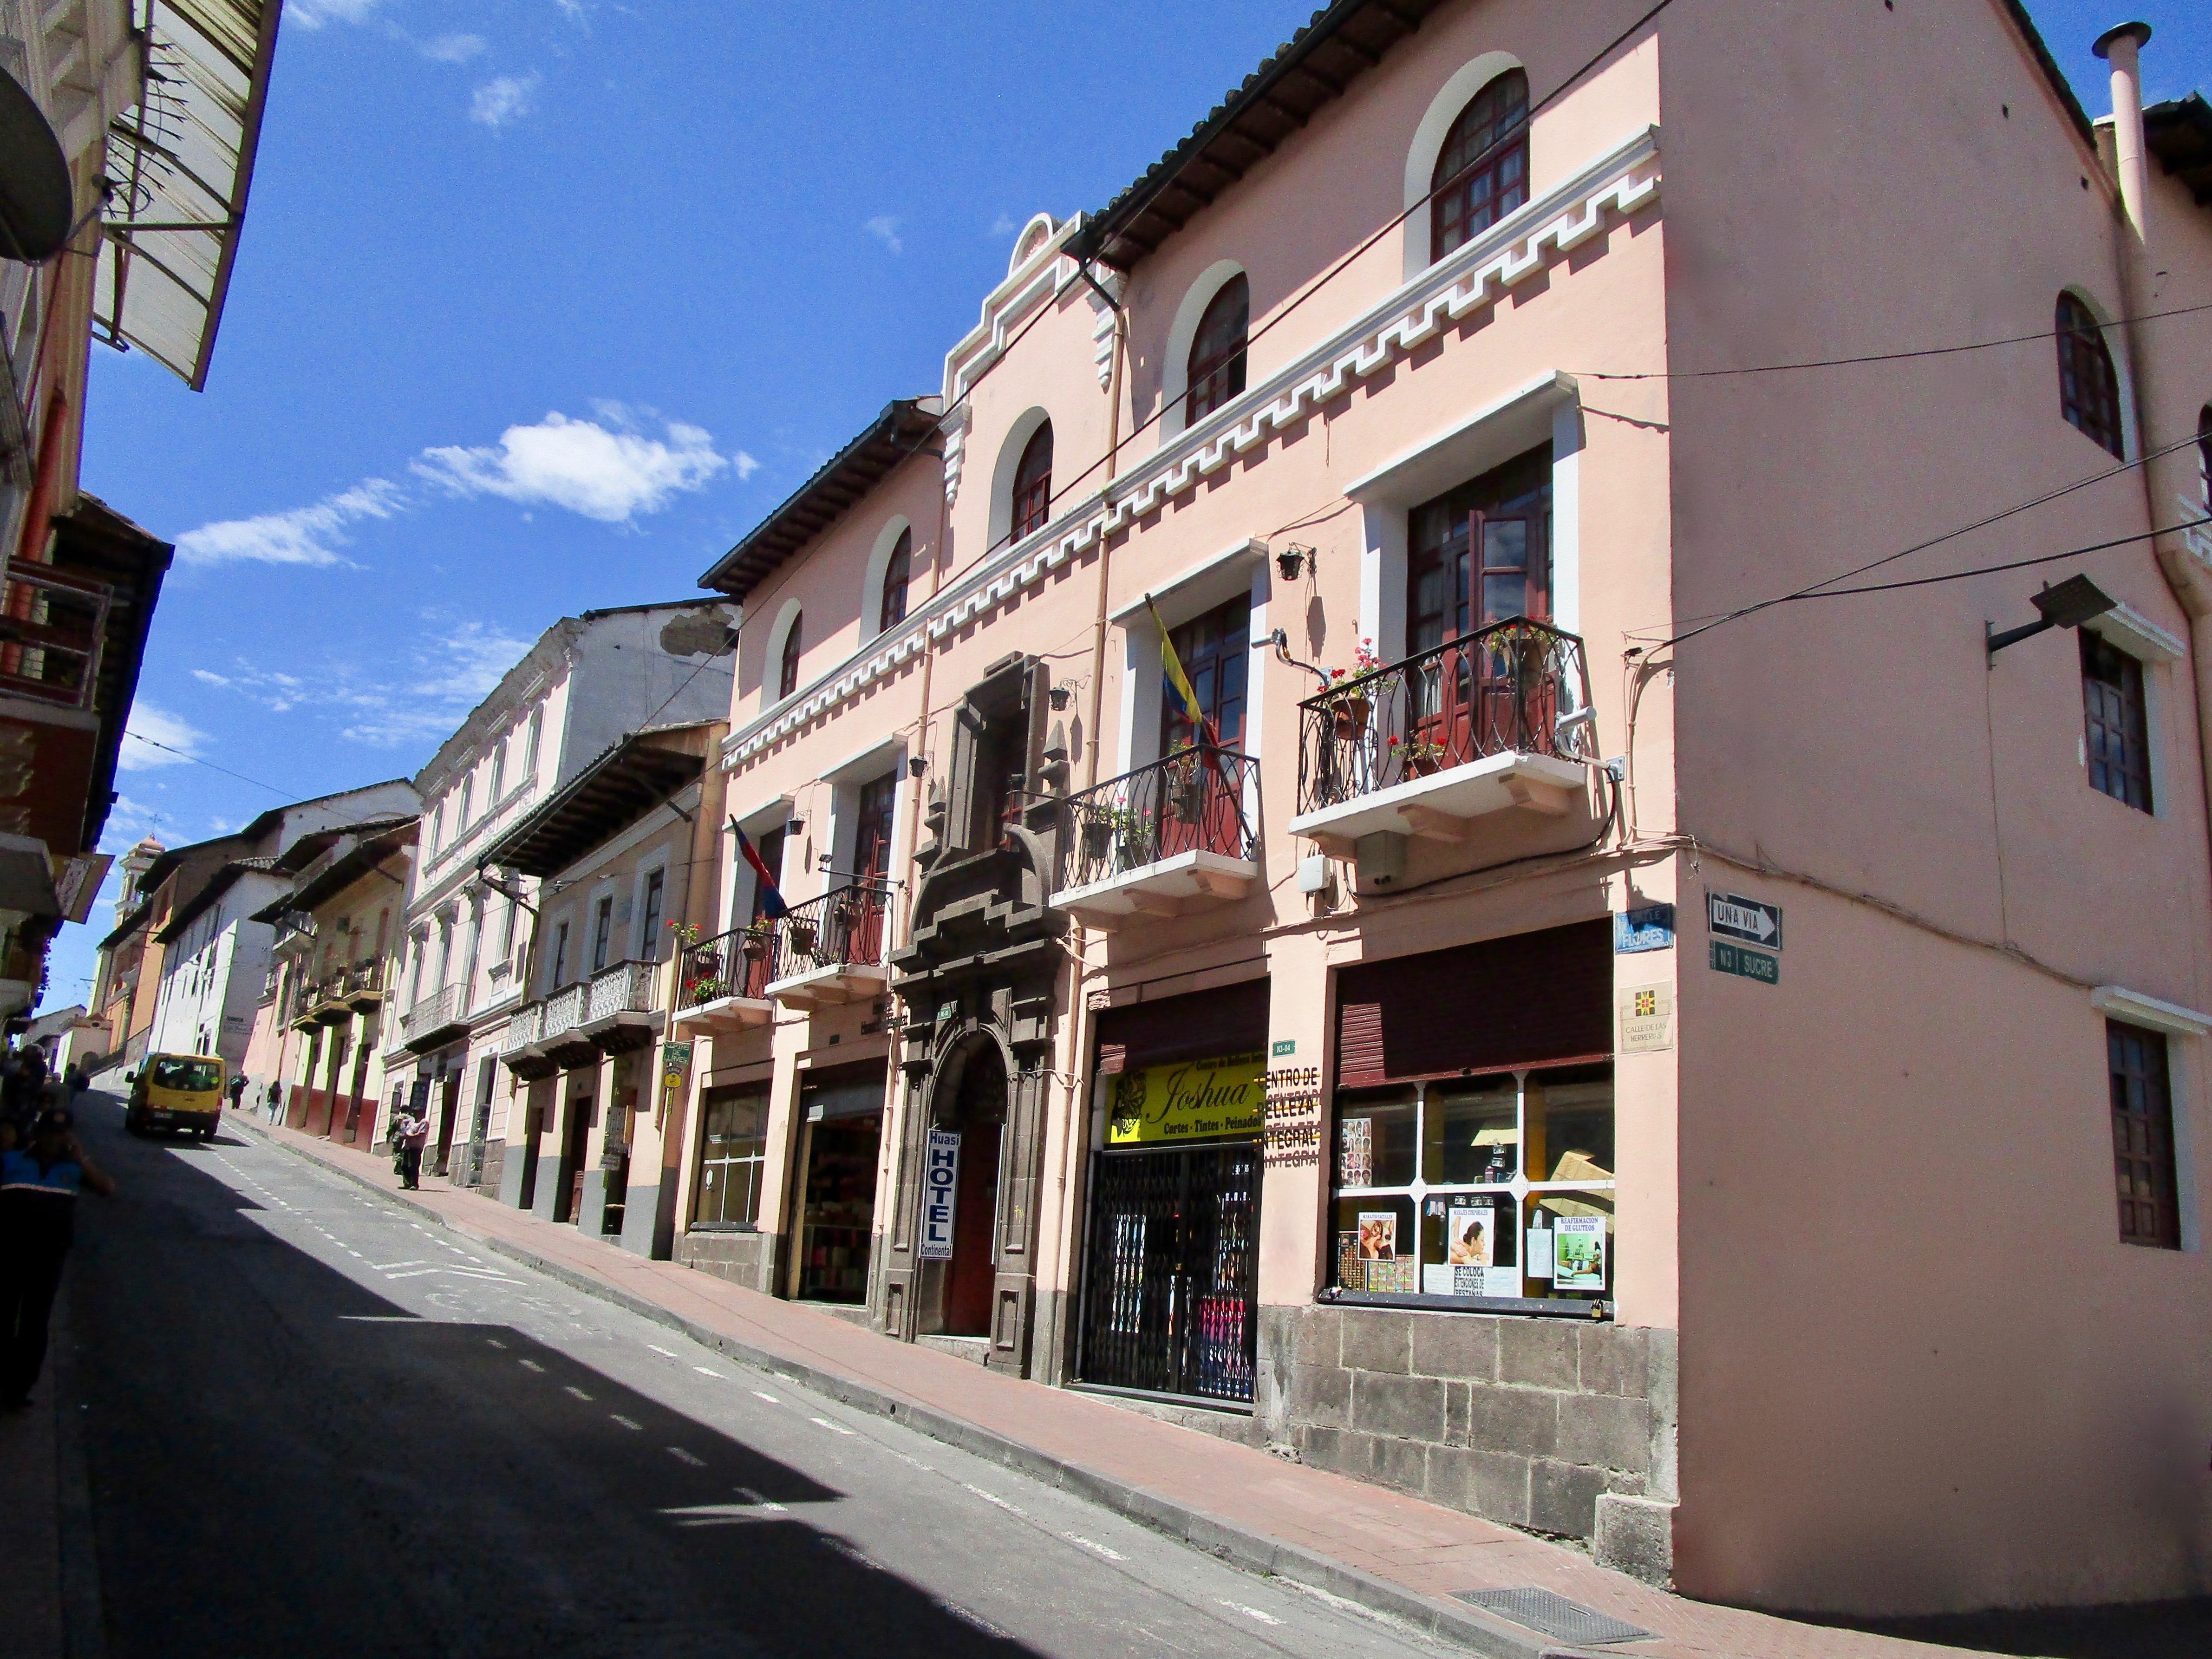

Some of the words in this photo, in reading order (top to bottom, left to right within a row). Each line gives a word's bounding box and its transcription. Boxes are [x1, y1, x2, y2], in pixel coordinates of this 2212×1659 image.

[1718, 904, 1738, 925] UNA
[1743, 911, 1758, 931] VIA
[1623, 928, 1664, 947] FLORES
[1744, 955, 1773, 978] SUCRE
[1625, 1025, 1644, 1034] CALLE
[1303, 1067, 1318, 1086] DE
[1145, 1062, 1251, 1124] Joshua
[1258, 1094, 1315, 1119] BELLEZA
[1164, 1122, 1188, 1136] Cortes
[1194, 1119, 1219, 1133] Tintes
[930, 1132, 959, 1146] Huasi
[928, 1149, 955, 1242] HOTEL
[921, 1243, 952, 1256] Continental
[1455, 1266, 1462, 1276] SE
[1463, 1267, 1484, 1278] COLOCA
[1480, 1278, 1484, 1289] DE
